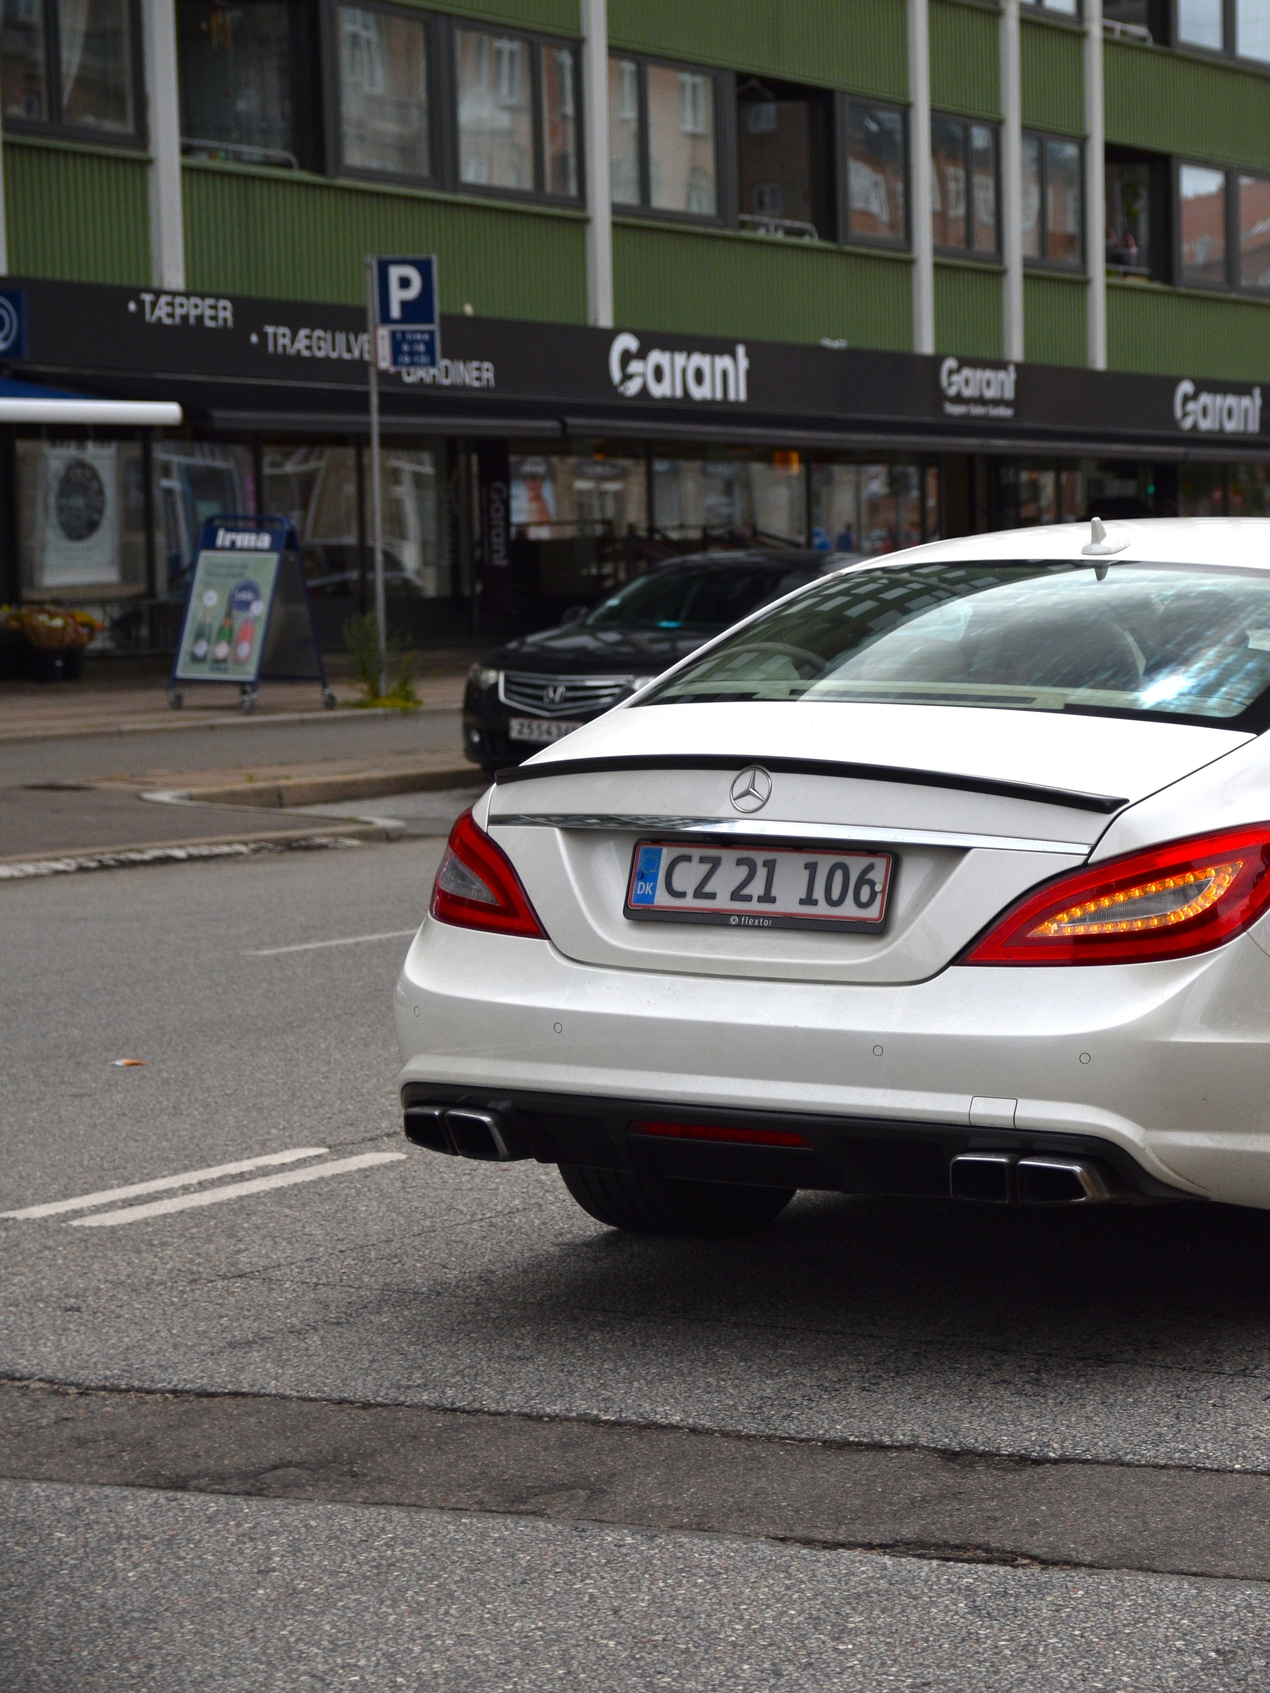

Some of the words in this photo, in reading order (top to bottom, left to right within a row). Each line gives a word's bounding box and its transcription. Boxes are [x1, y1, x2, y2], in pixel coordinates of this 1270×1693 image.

[140, 293, 234, 329] TÆPPER
[388, 264, 423, 320] P
[609, 332, 750, 402] Garant
[940, 357, 1017, 401] Garant
[1174, 379, 1263, 434] Garant
[216, 528, 272, 550] Irma
[637, 881, 654, 896] DK
[664, 854, 722, 900] CZ
[730, 857, 777, 904] 21
[799, 861, 879, 910] 106
